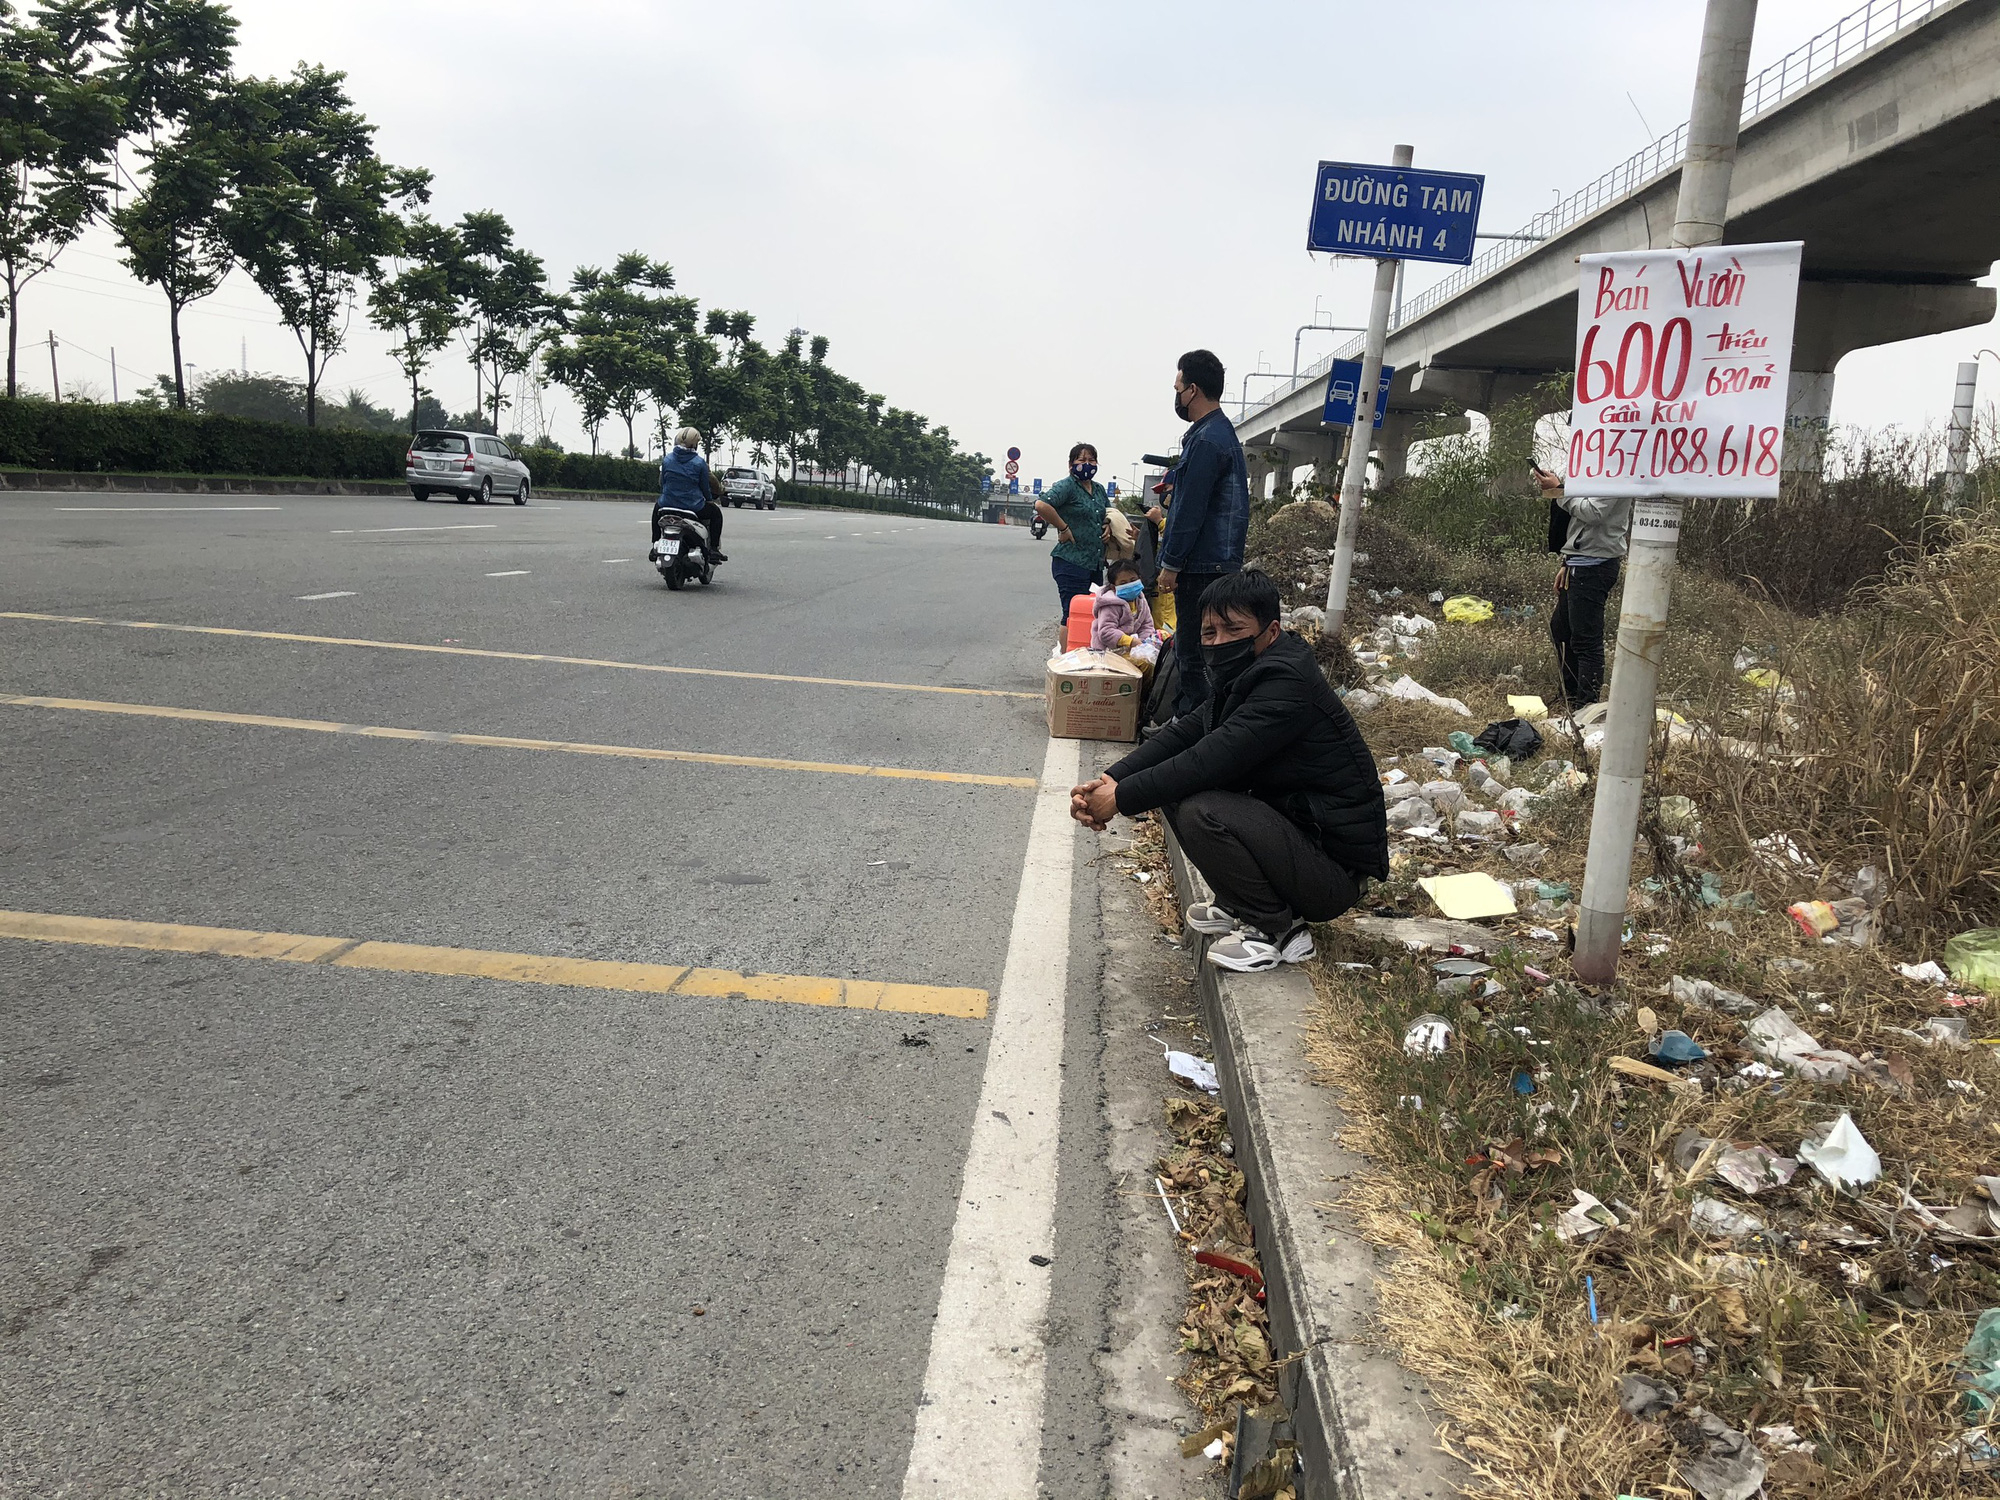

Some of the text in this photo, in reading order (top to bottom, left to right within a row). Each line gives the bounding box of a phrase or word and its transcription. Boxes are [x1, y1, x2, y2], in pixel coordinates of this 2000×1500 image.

[1325, 174, 1472, 215] ĐƯỜNG TẠM
[1337, 217, 1447, 251] NHÁNH 4
[1594, 257, 1746, 319] Bán Vườn
[1576, 317, 1768, 404] 600 triệu
[1599, 400, 1697, 425] Gần KCN
[1568, 424, 1780, 479] 0937.088.618
